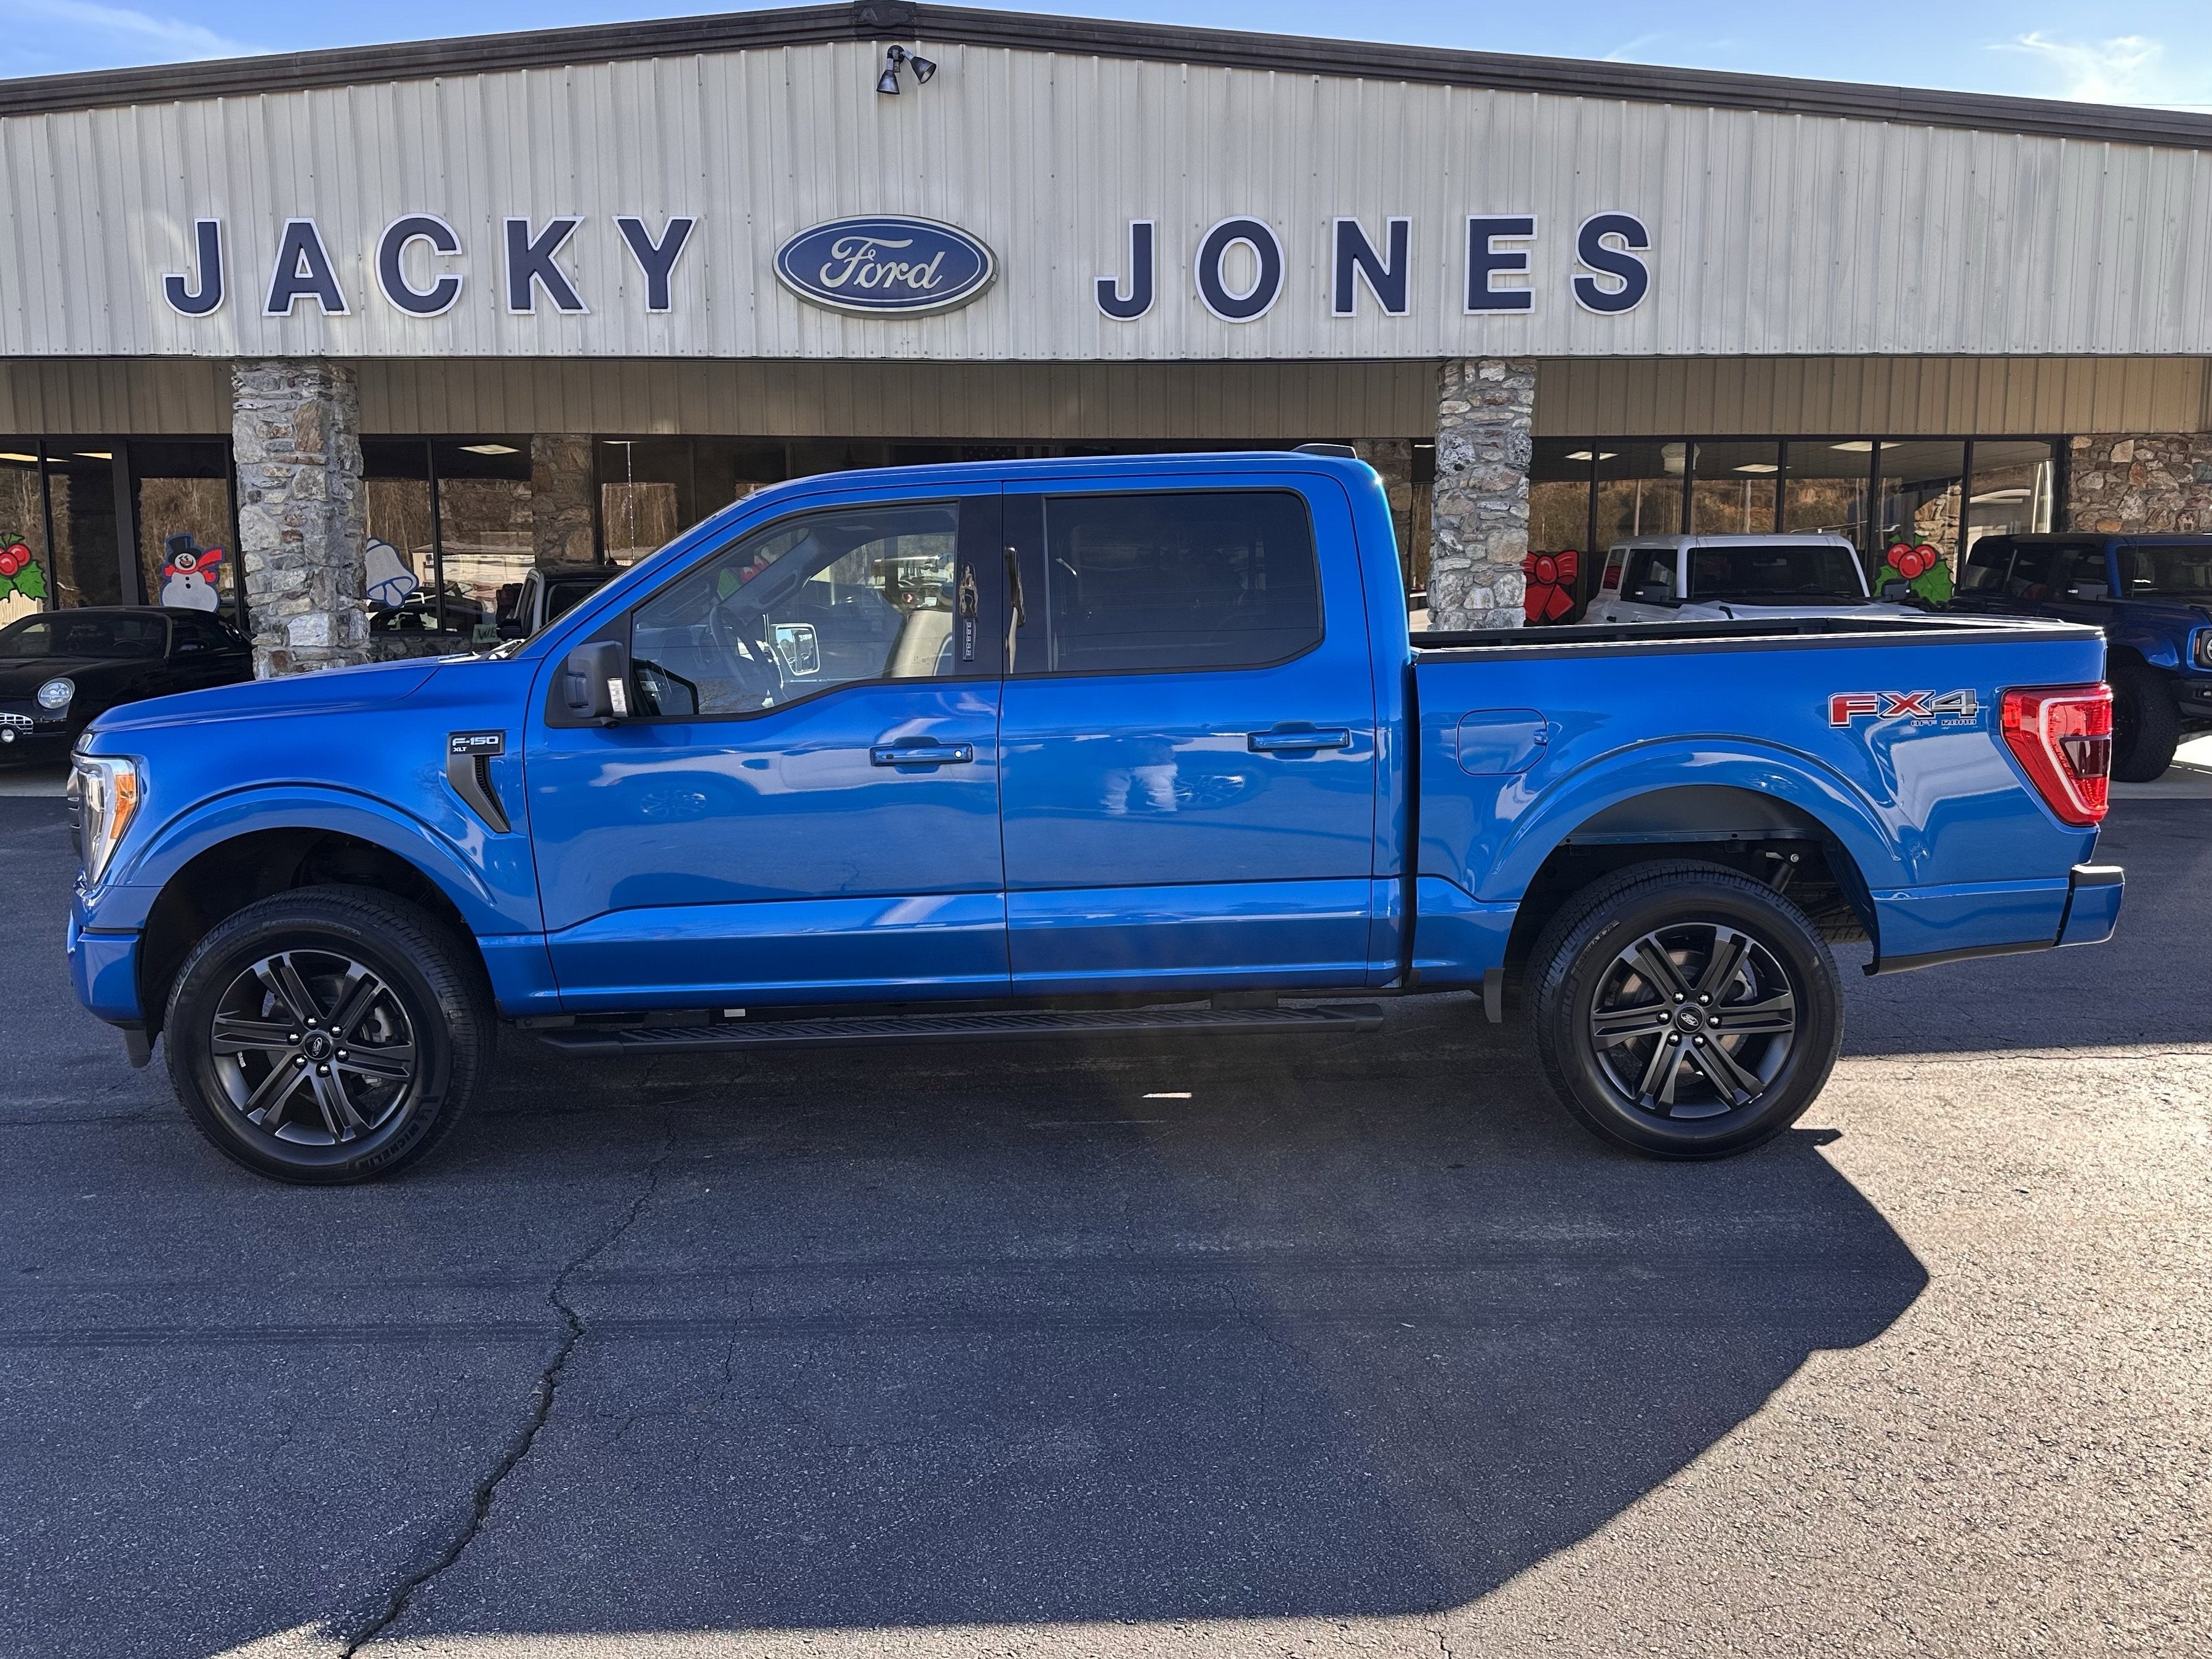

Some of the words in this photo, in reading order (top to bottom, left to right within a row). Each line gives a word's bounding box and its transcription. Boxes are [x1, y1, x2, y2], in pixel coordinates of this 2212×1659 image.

[162, 213, 698, 318] JACKY
[1094, 210, 1652, 324] JONES
[819, 236, 946, 289] Ford
[1828, 689, 1979, 729] FX4
[452, 735, 499, 746] F-150
[358, 1122, 420, 1169] MICHELIN
